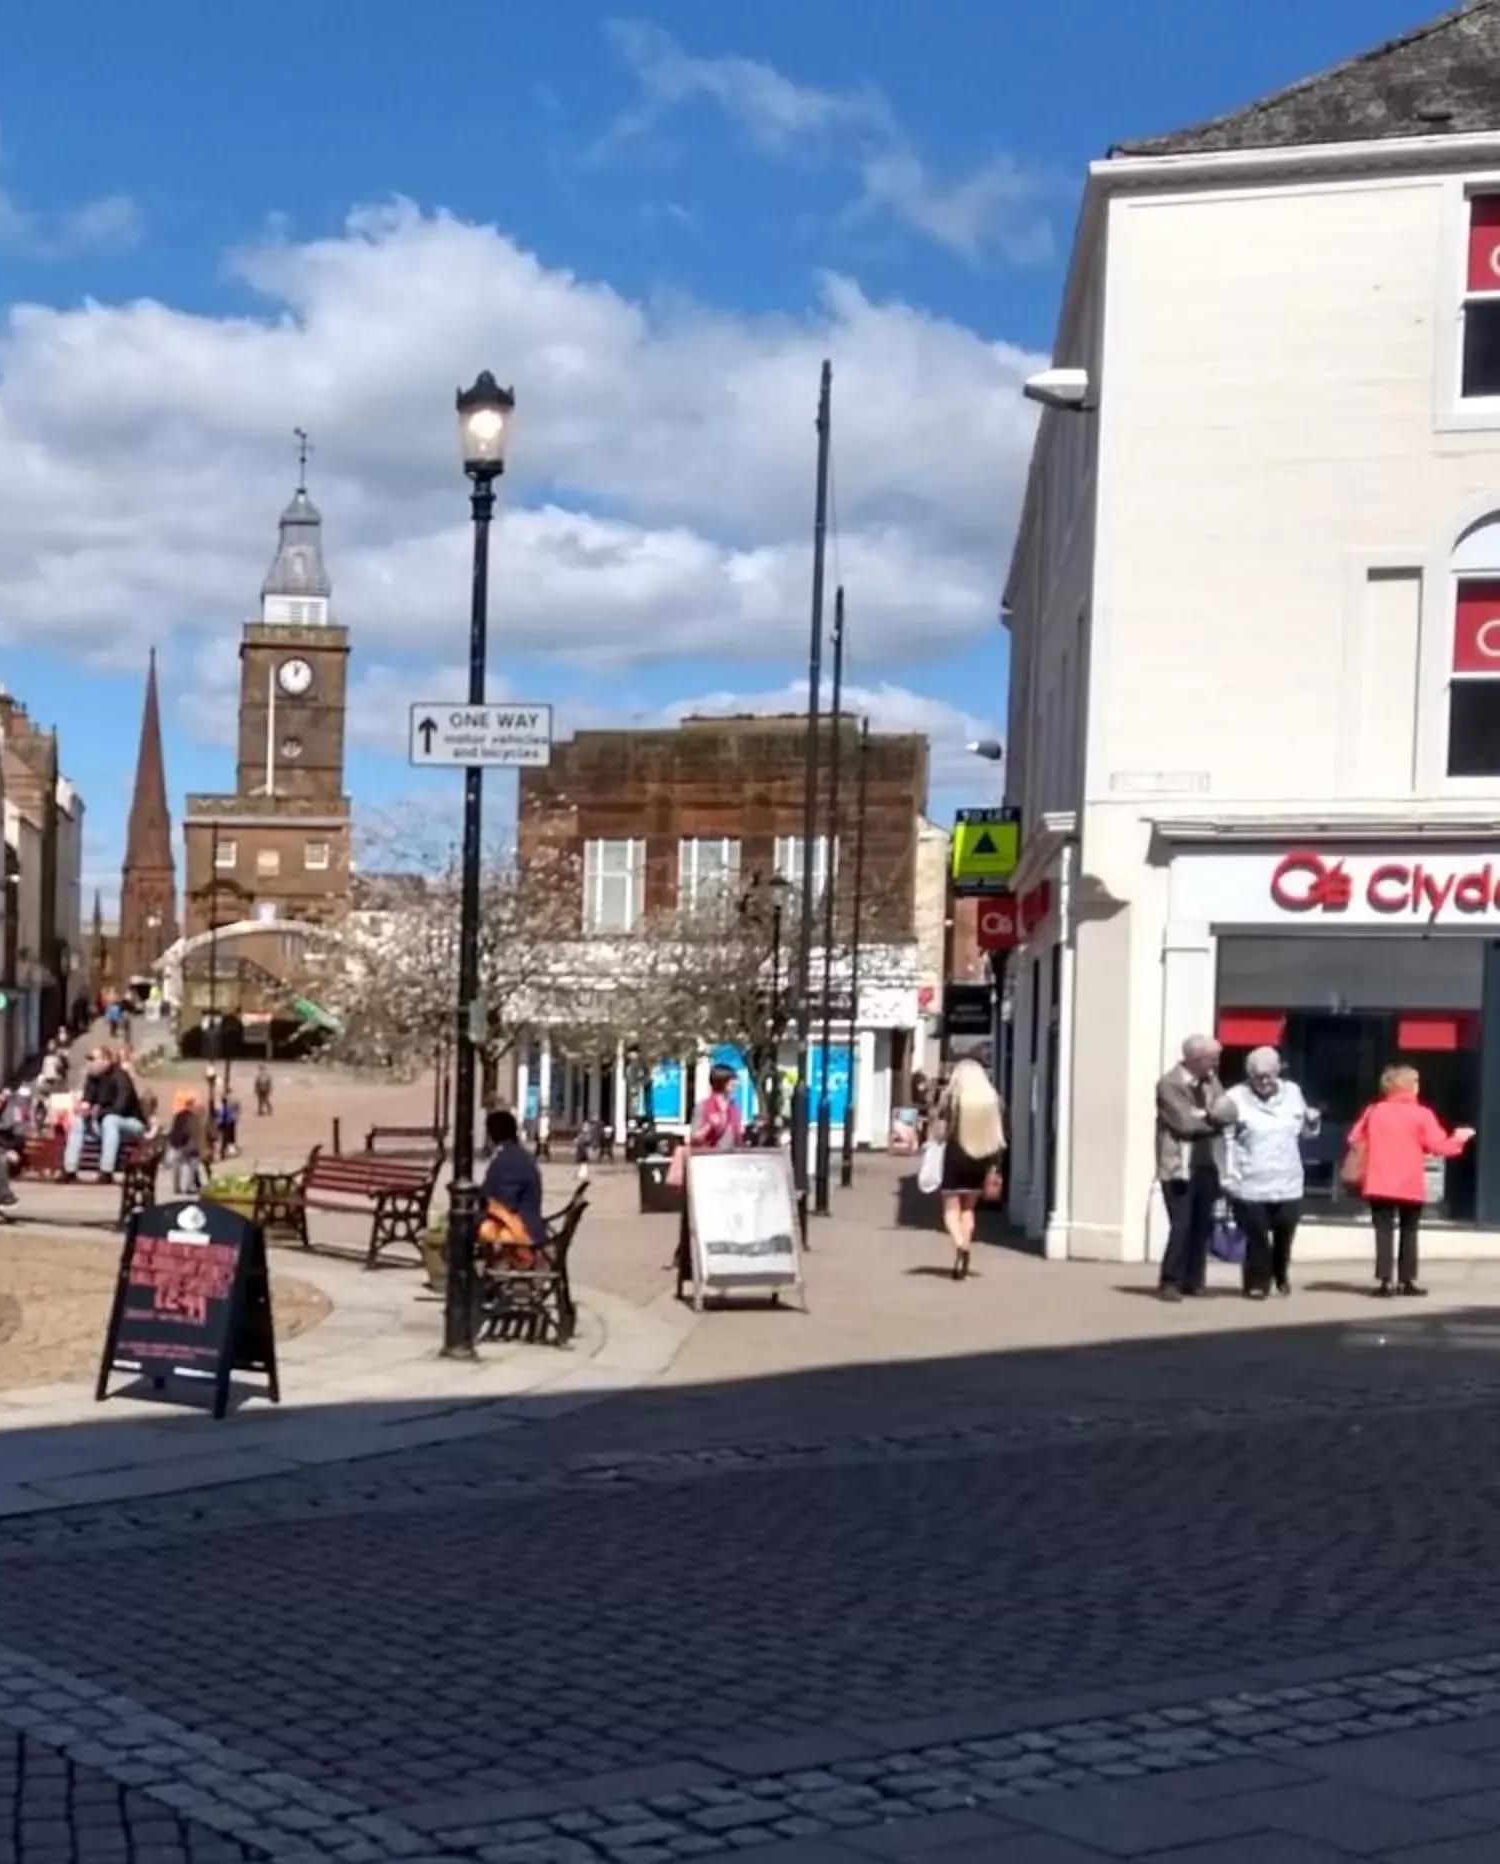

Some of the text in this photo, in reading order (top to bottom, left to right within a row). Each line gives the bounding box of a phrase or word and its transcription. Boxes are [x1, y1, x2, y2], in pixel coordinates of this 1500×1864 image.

[449, 712, 538, 728] ONE WAY
[491, 732, 549, 744] vehicles
[453, 747, 538, 761] and bicycles
[1366, 862, 1500, 923] Clyd
